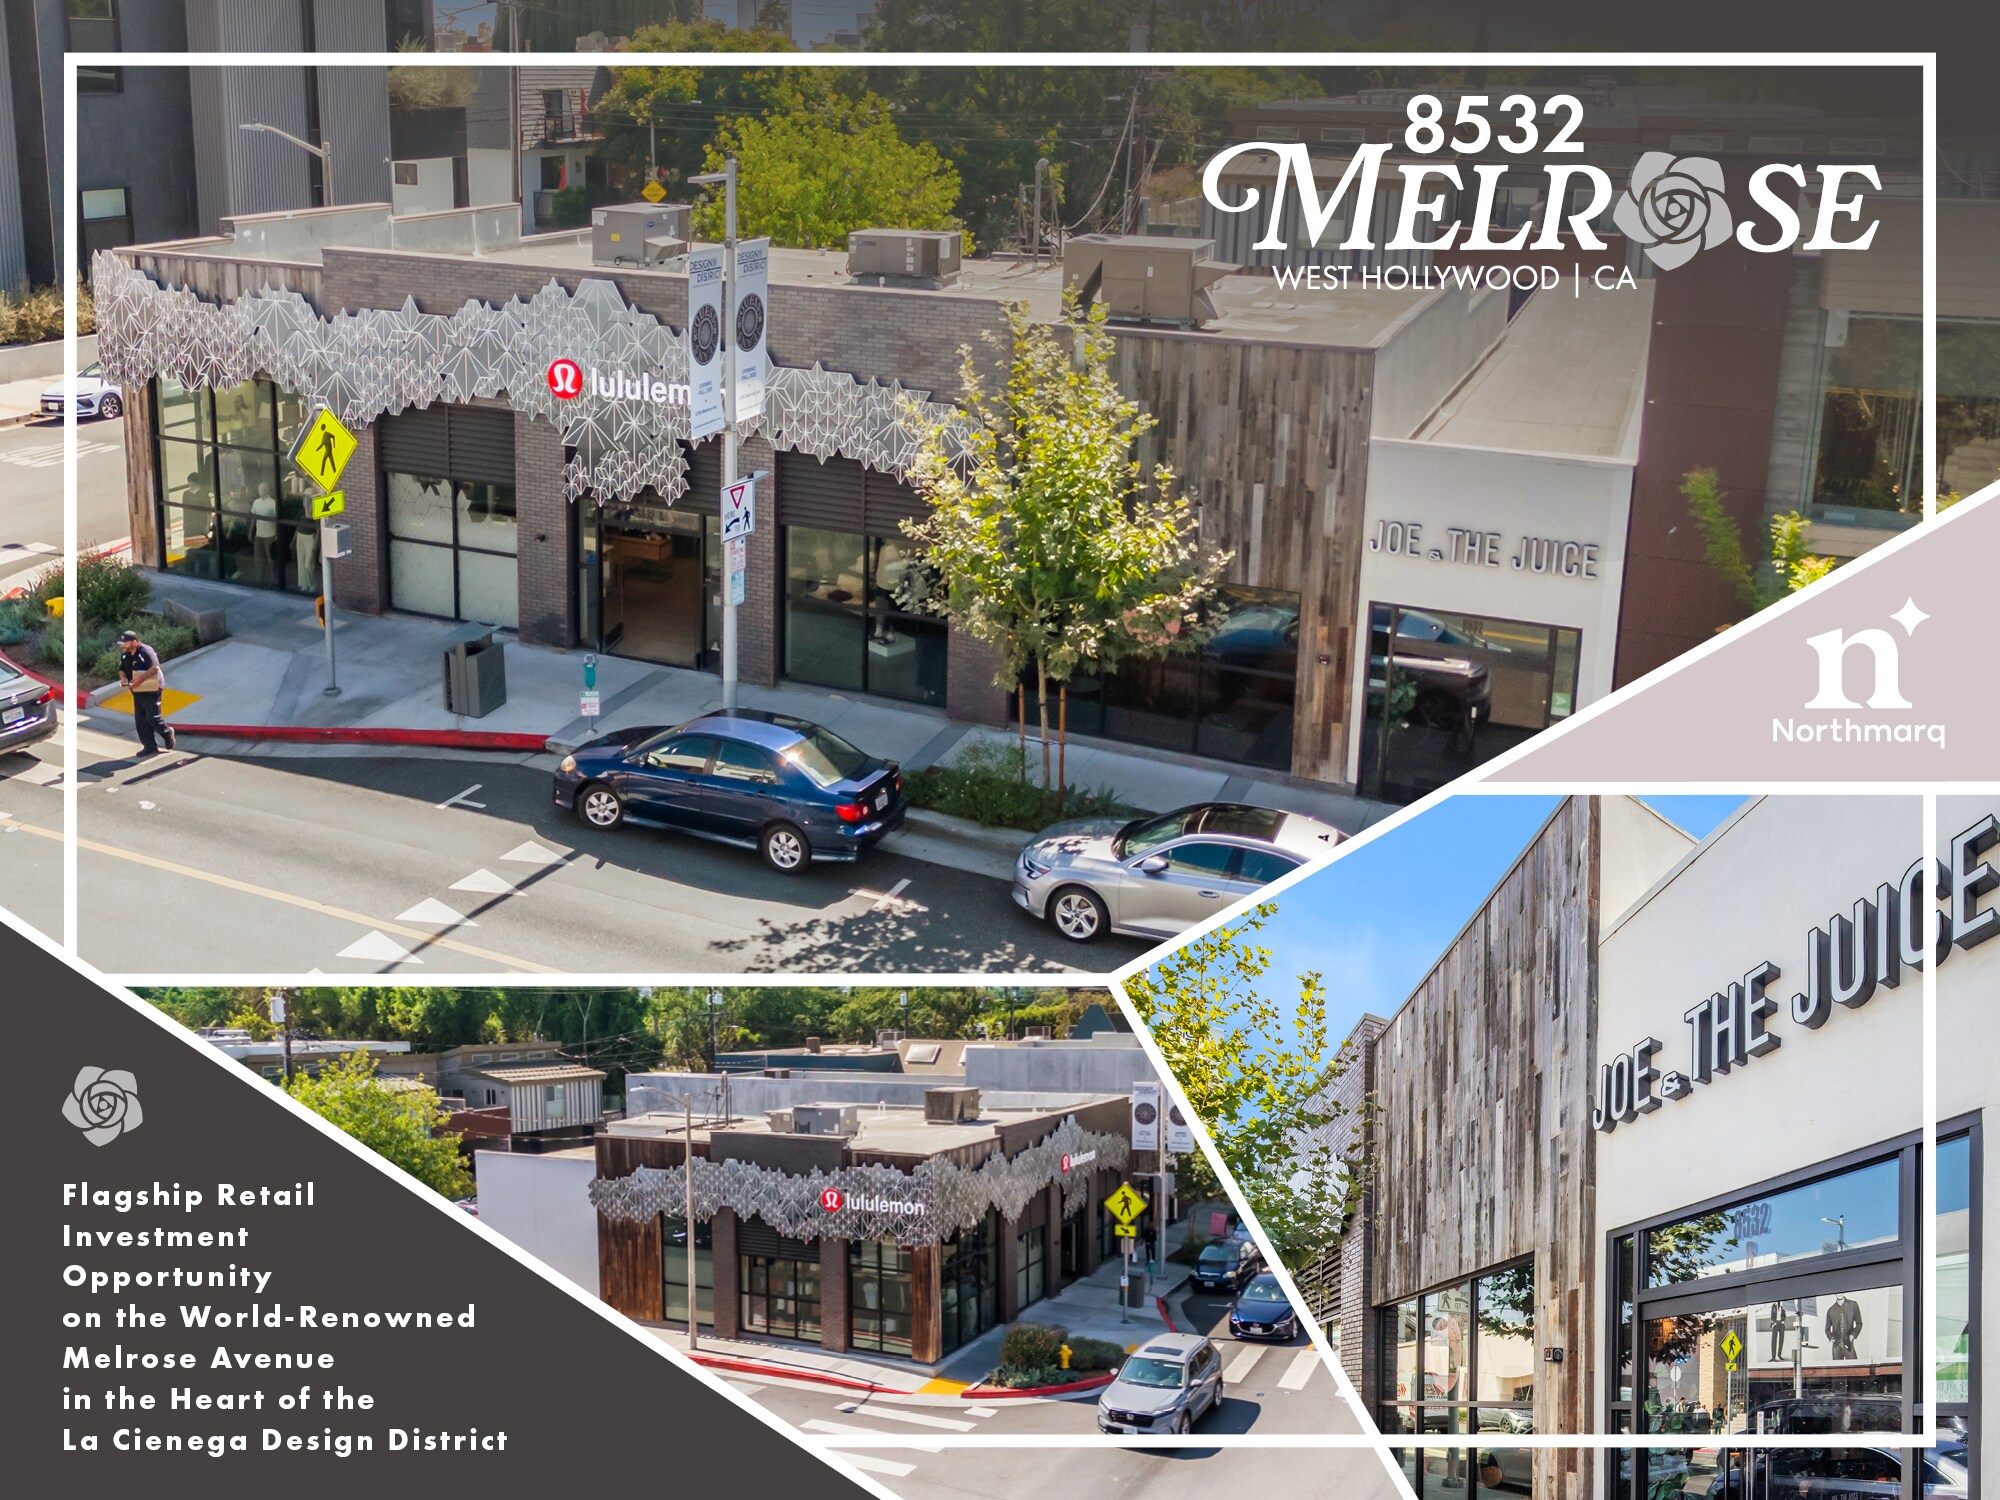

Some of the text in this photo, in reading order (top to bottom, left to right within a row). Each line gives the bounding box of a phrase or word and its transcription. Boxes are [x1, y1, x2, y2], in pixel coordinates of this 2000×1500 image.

[591, 367, 727, 406] lululem
[1369, 520, 1600, 580] JOE & THE JUICE
[1592, 813, 2000, 1134] JOE & THE JUICE
[846, 1192, 925, 1216] lululemon
[1734, 1202, 1771, 1240] 8532
